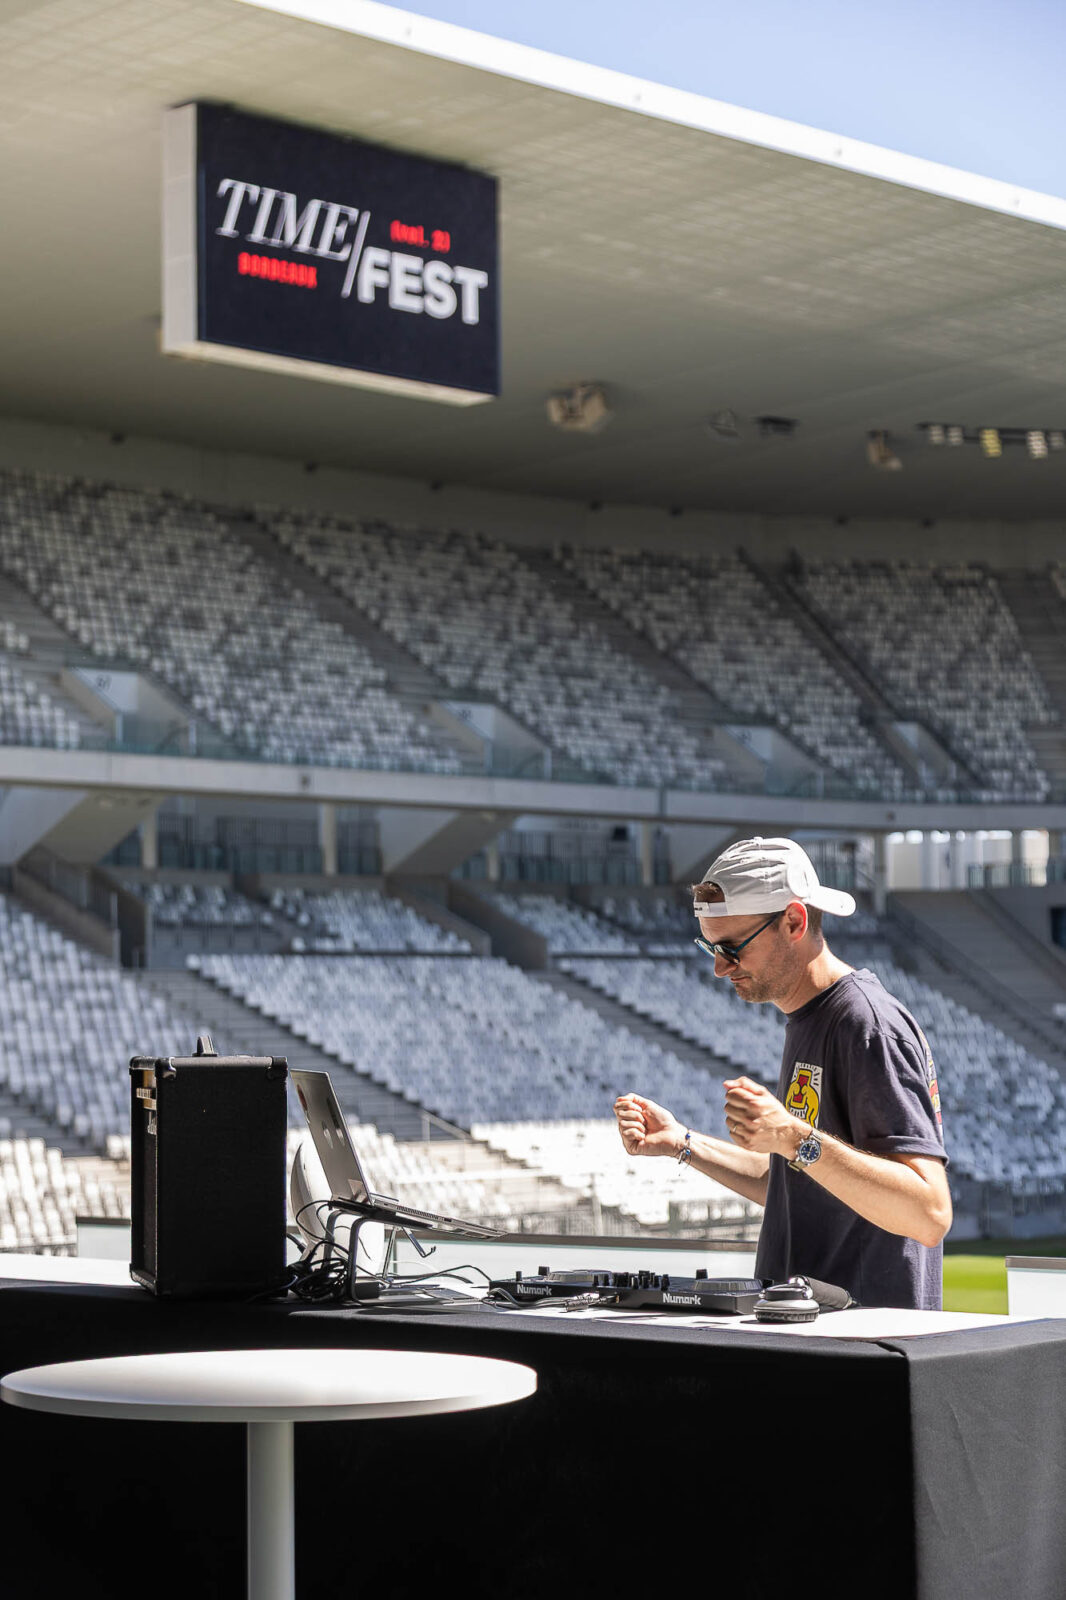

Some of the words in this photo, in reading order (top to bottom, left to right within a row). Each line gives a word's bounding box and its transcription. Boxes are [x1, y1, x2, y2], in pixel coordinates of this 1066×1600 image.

[215, 178, 359, 262] TIME
[357, 246, 488, 325] FEST
[516, 1284, 552, 1296] Numark
[662, 1292, 702, 1305] Numark
